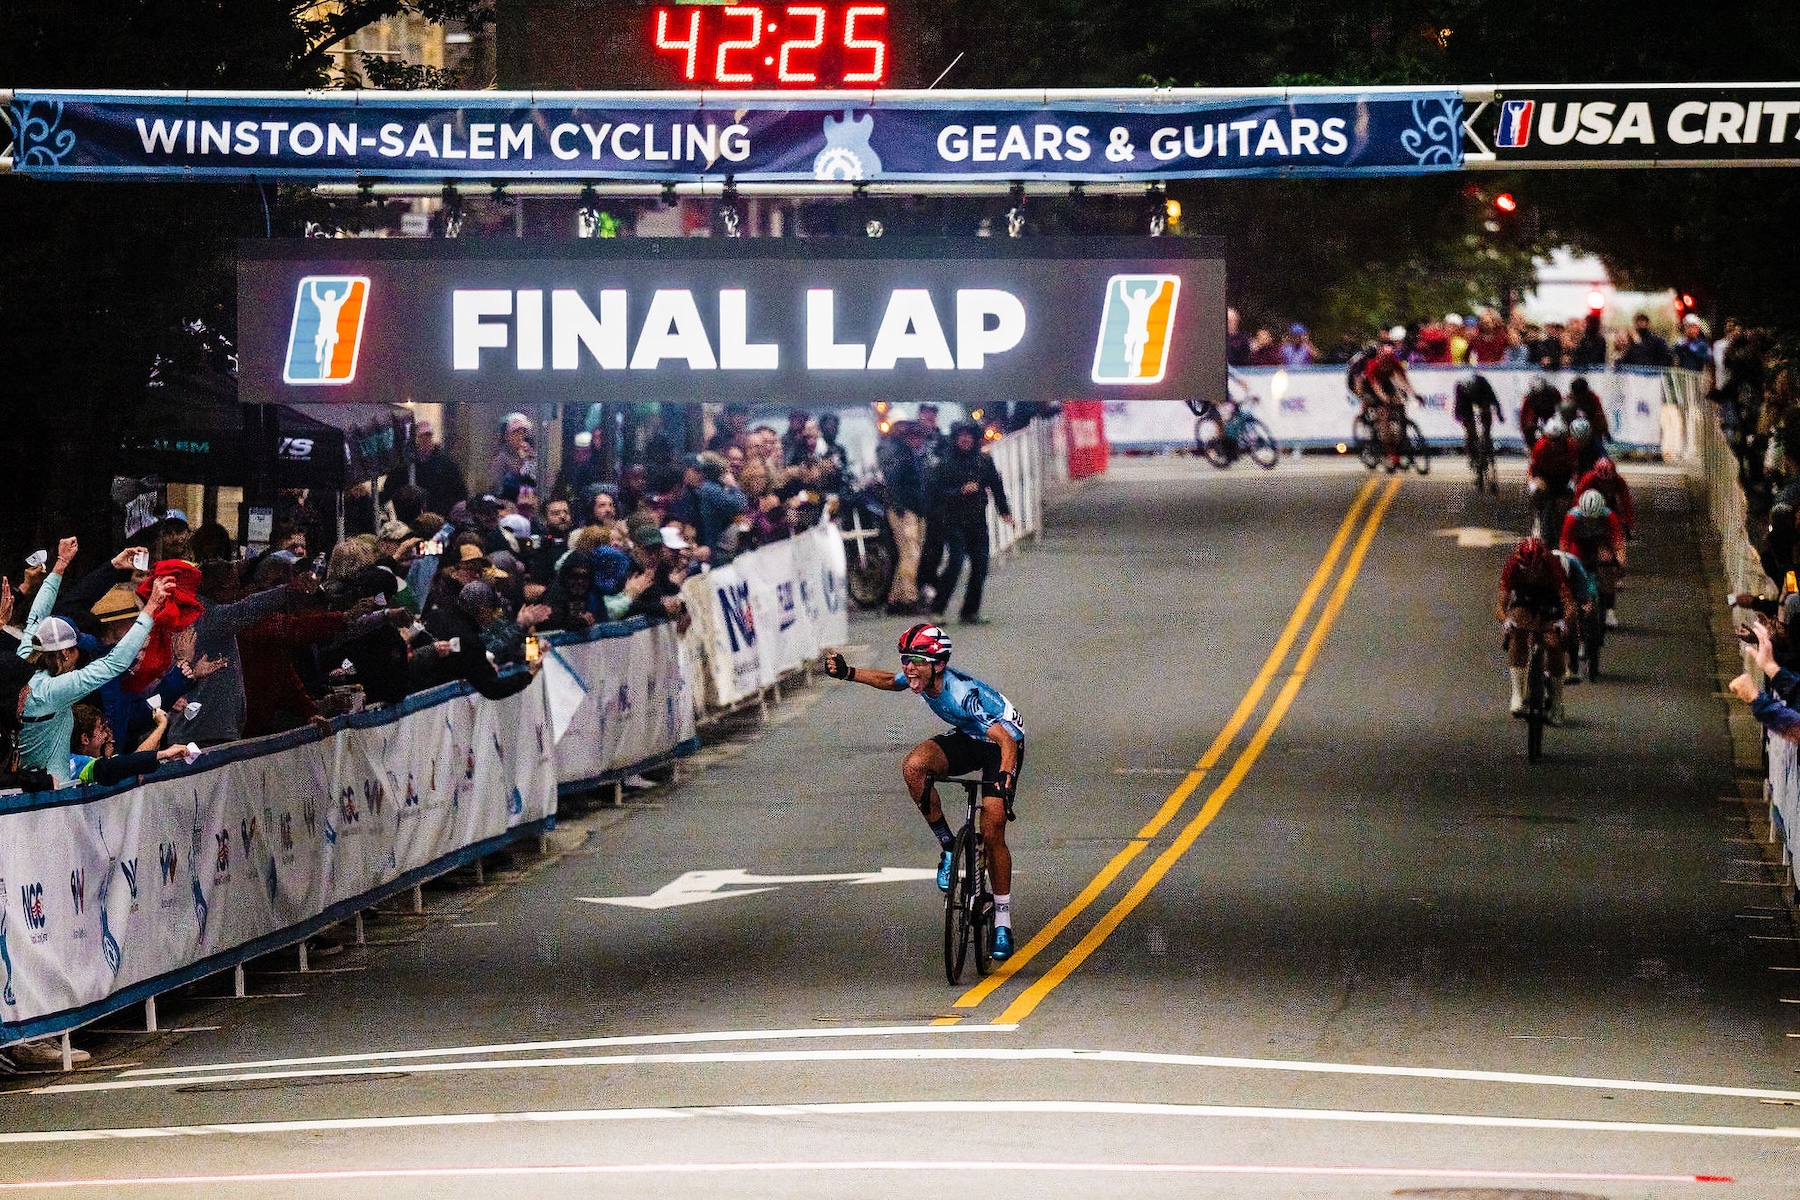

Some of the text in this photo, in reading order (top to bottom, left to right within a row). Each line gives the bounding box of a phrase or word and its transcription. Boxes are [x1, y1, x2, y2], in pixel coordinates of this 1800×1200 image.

[655, 6, 887, 83] 42:25
[135, 118, 752, 163] WINSTON-SALEM CYCLING
[936, 117, 1348, 163] GEARS & GUITARS
[1537, 100, 1800, 146] USA CRIT
[452, 287, 1028, 371] FINAL LAP
